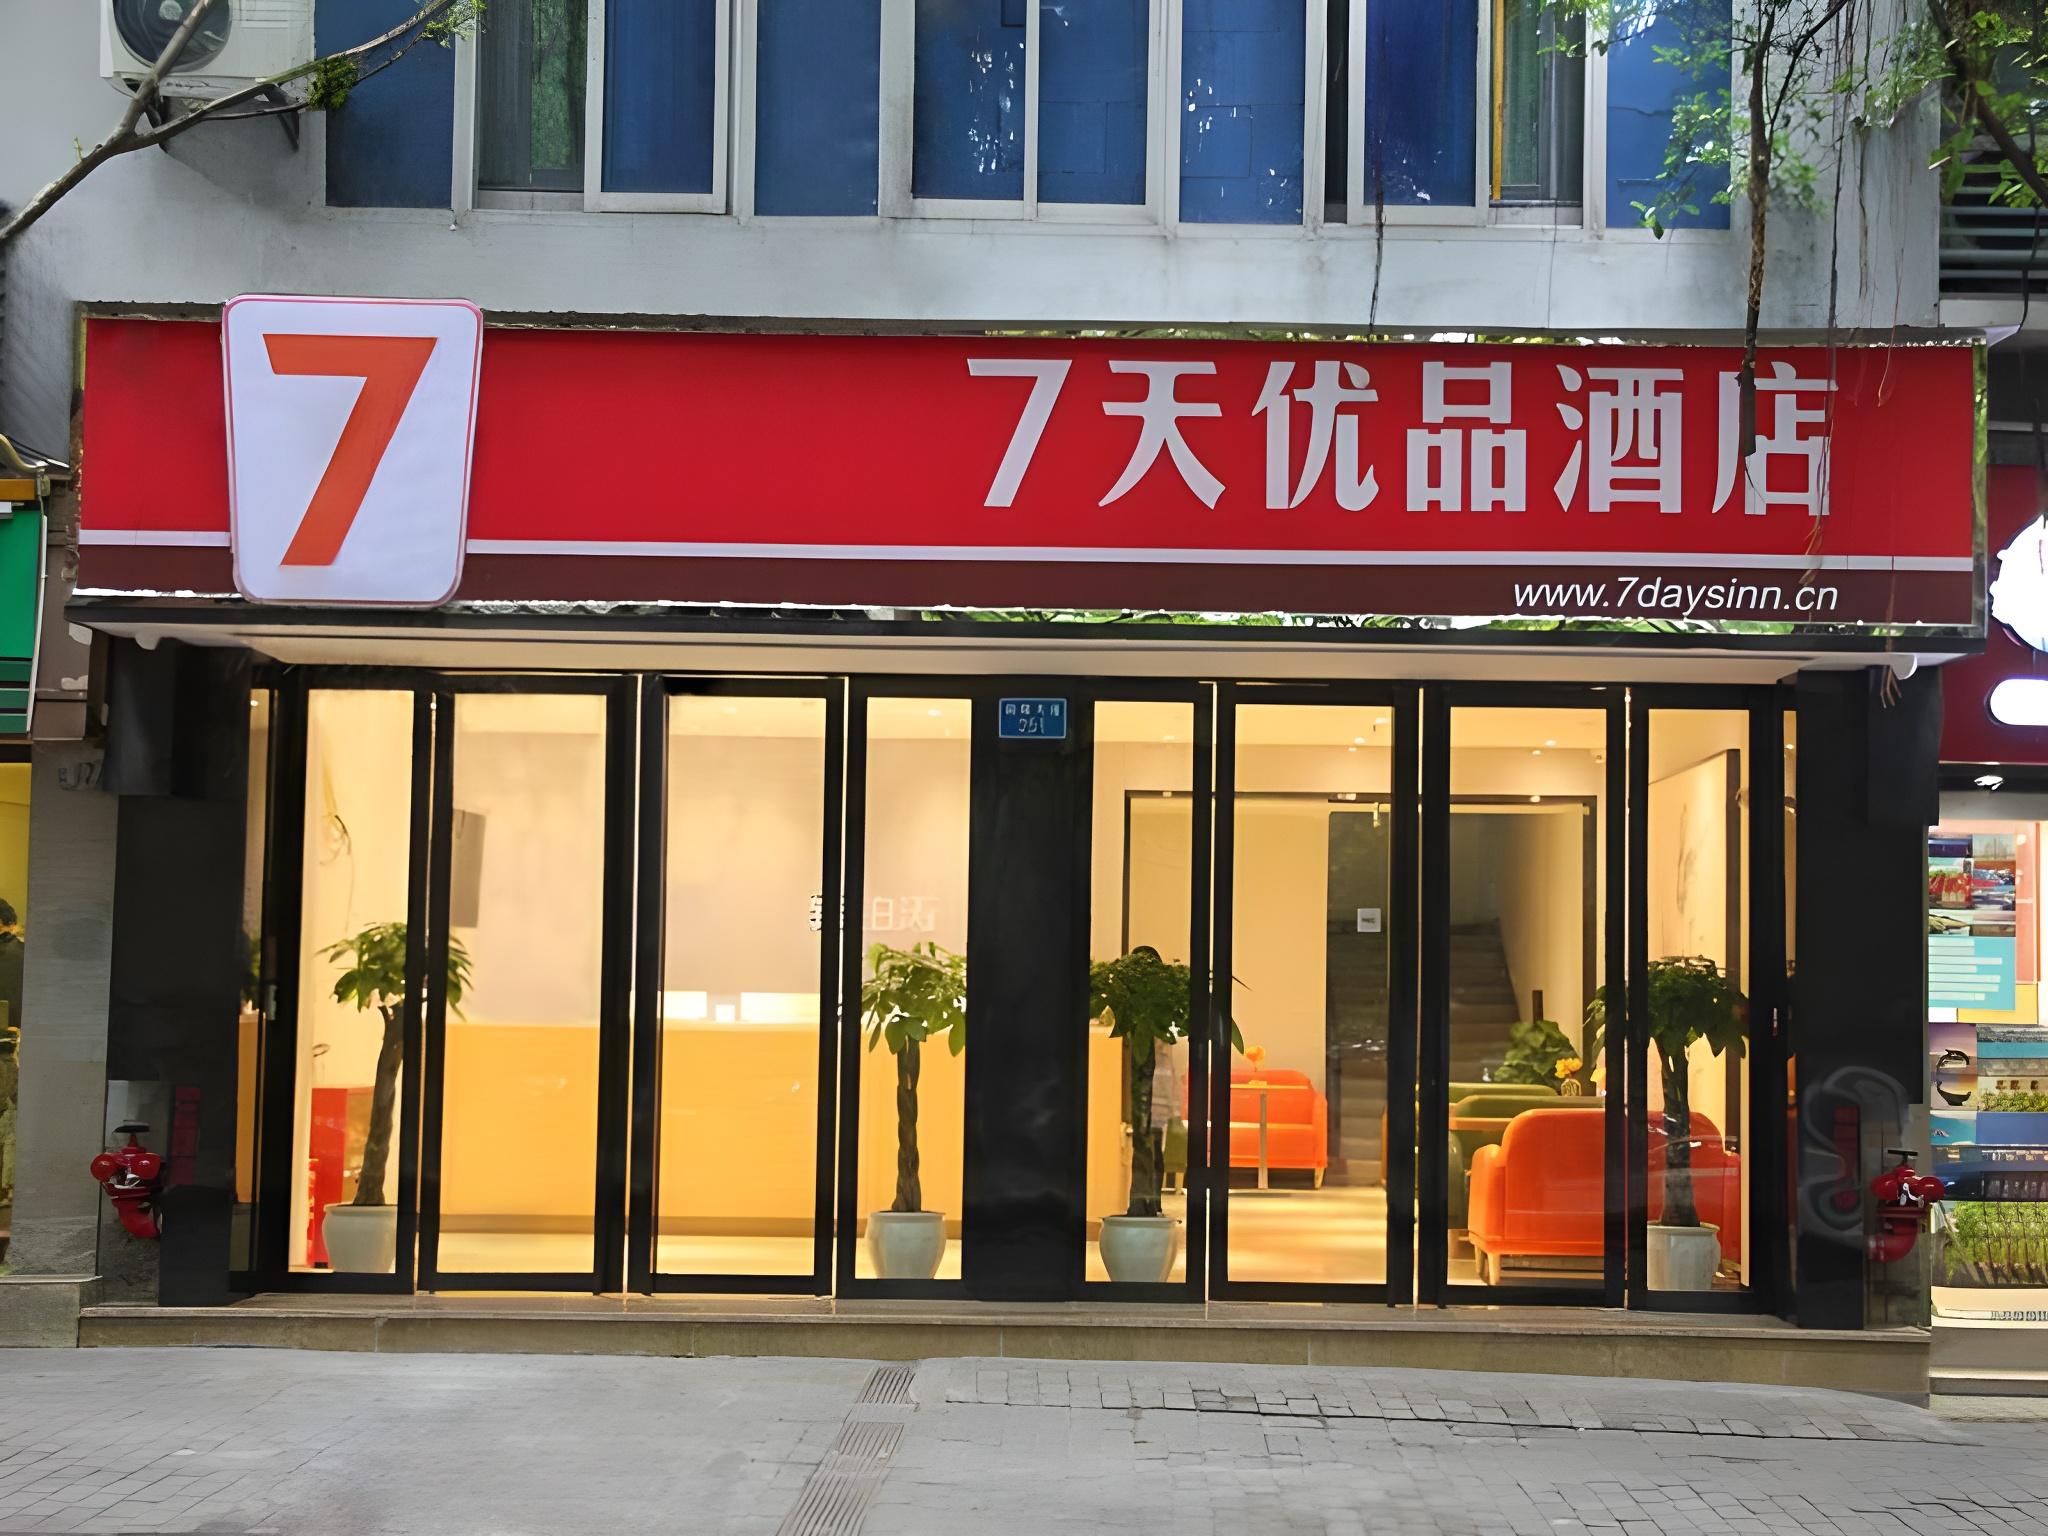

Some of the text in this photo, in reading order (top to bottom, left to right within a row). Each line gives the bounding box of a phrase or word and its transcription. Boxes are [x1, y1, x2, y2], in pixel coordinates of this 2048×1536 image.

[263, 334, 438, 566] 7
[966, 358, 1840, 517] 7天优品酒店
[1513, 576, 1839, 617] www.7daysinn.cn
